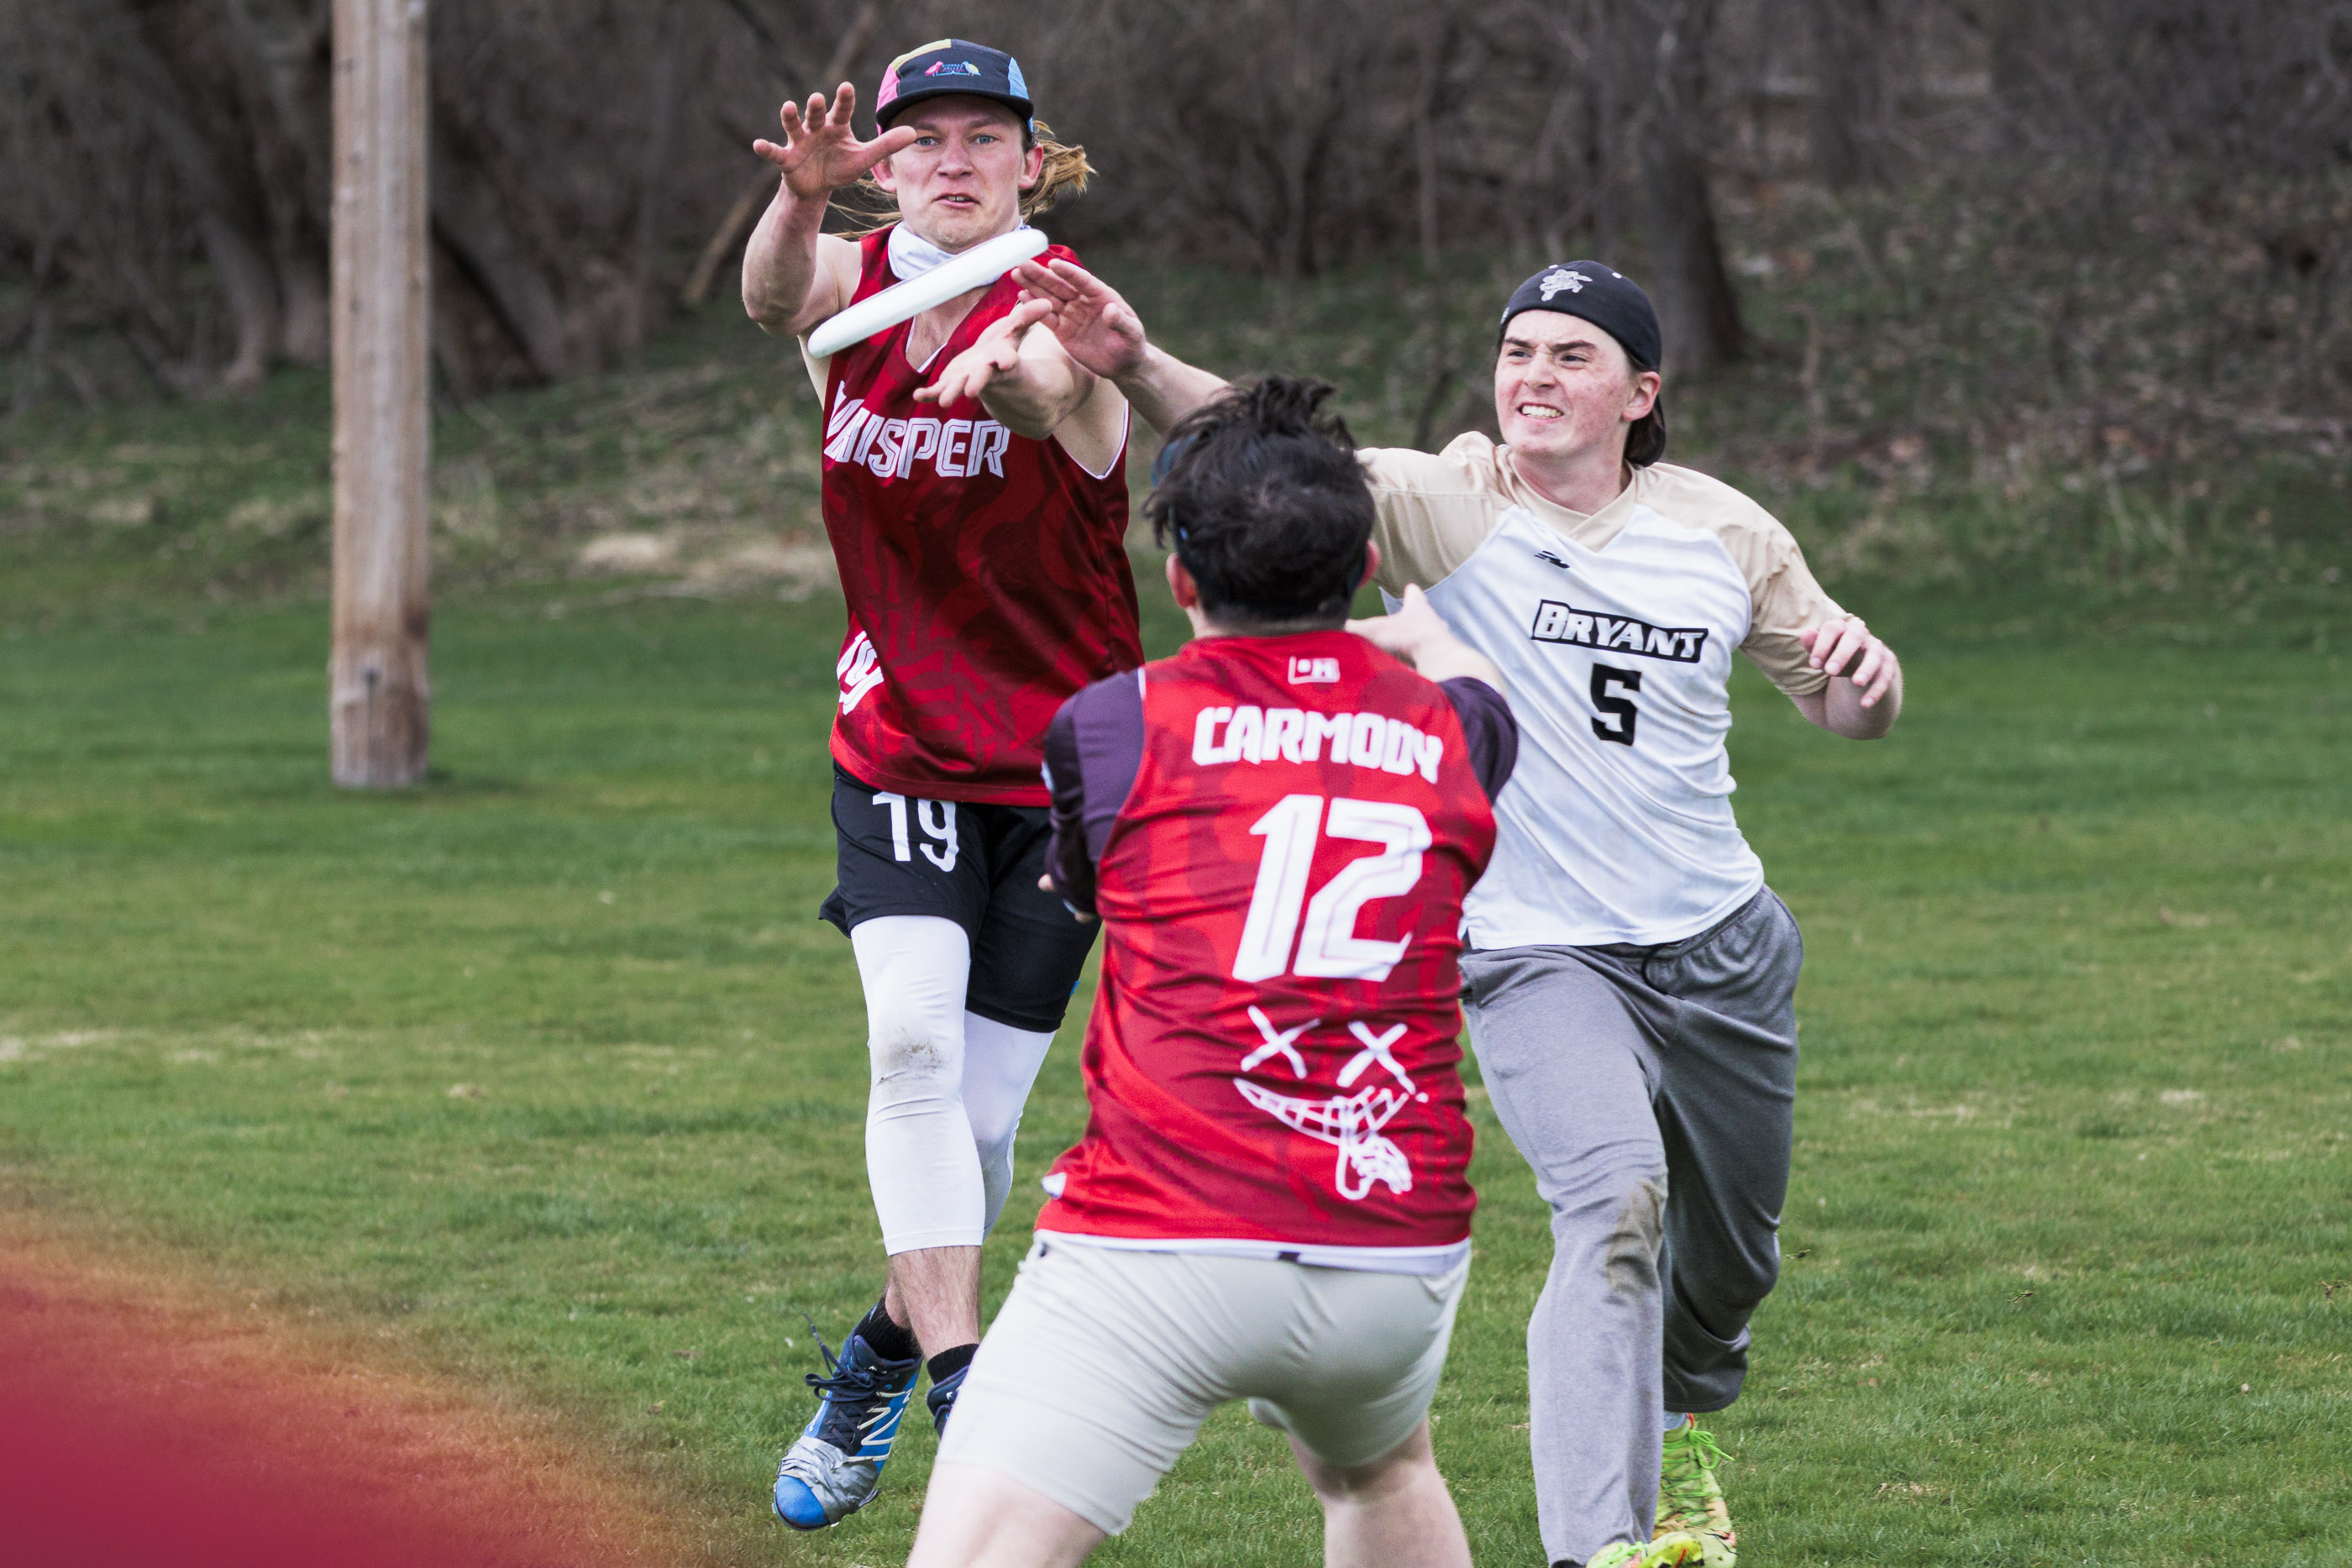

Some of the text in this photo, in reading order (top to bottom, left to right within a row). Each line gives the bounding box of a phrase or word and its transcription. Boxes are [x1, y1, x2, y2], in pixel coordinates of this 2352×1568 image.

[1533, 601, 1705, 659] BRYANT
[1192, 705, 1444, 784] CARMODY
[1590, 663, 1642, 747] 5
[872, 790, 959, 873] 19
[1231, 794, 1433, 983] 12
